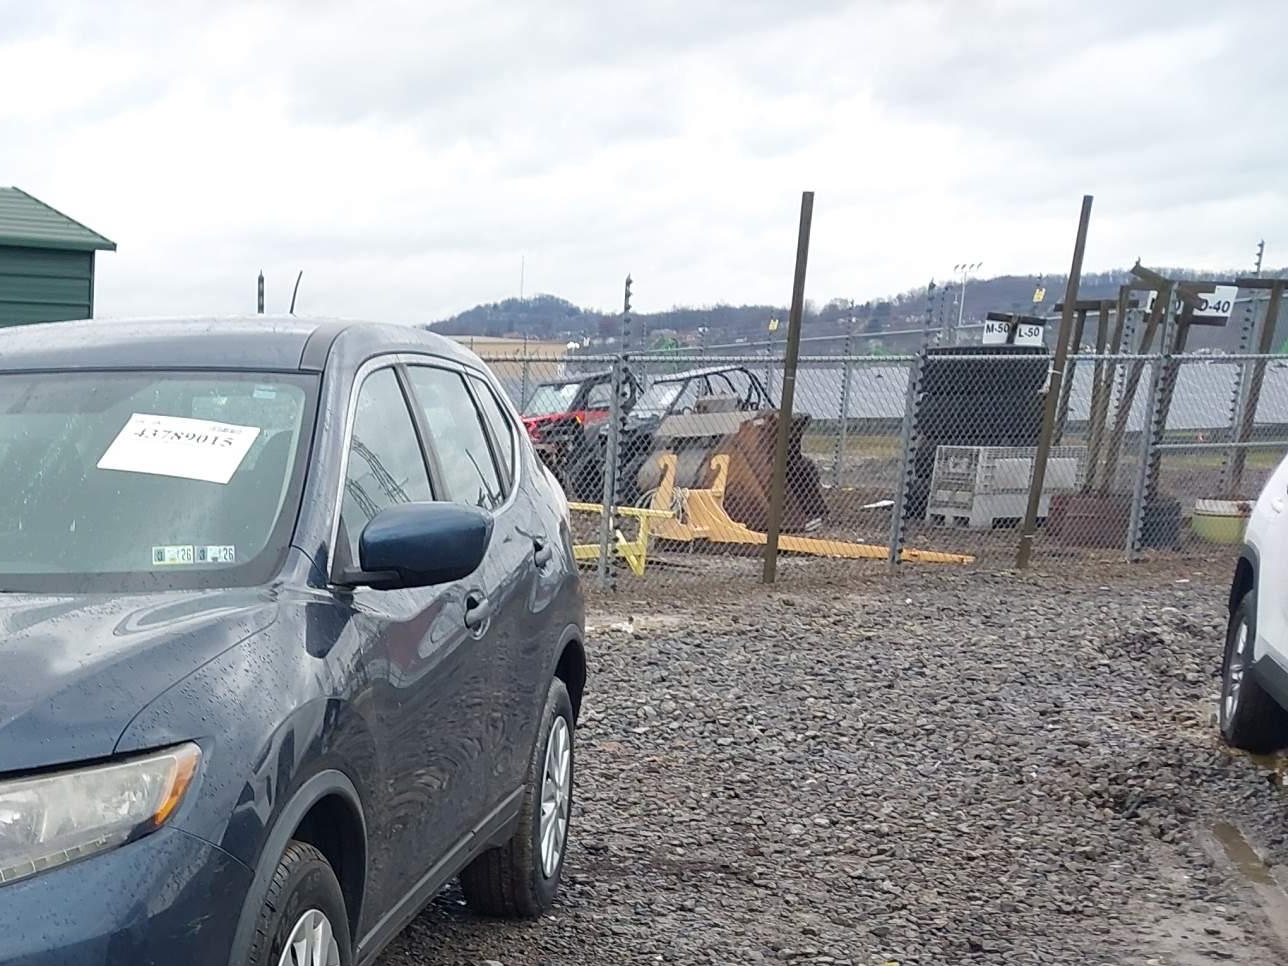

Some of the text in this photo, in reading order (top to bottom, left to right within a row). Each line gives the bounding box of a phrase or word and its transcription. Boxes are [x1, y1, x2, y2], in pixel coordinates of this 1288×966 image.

[986, 323, 1010, 334] M-50
[1018, 327, 1040, 337] L-50
[134, 428, 235, 447] 43789015
